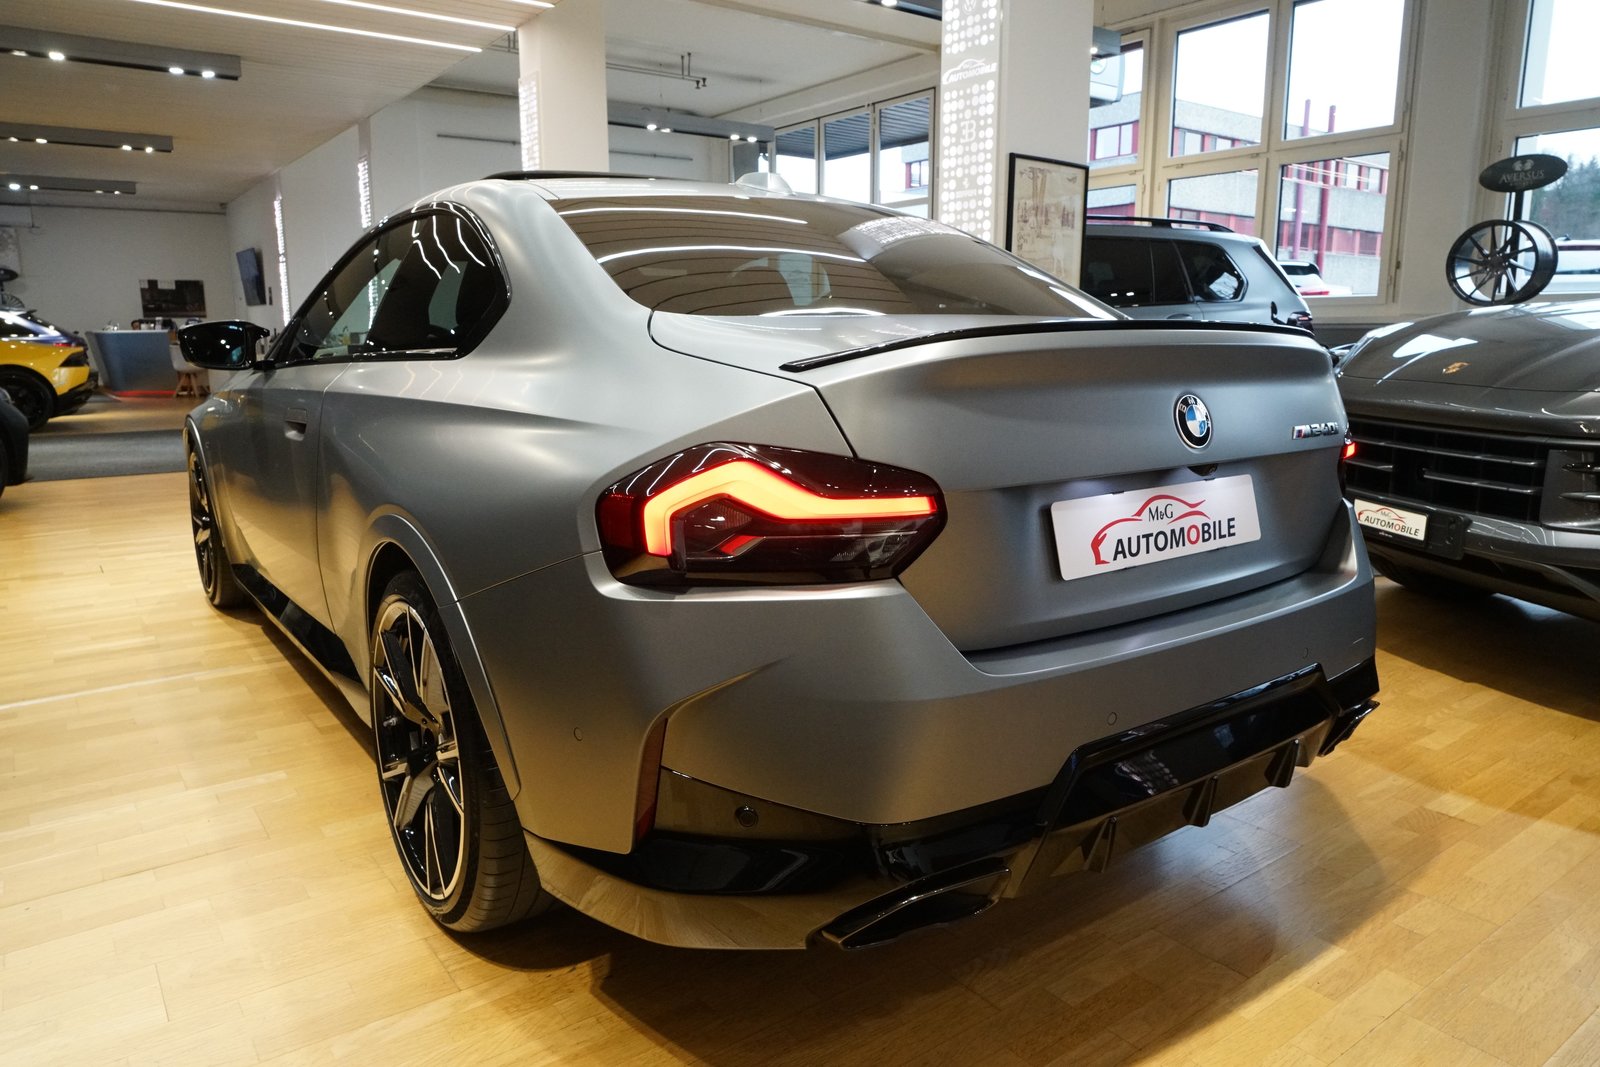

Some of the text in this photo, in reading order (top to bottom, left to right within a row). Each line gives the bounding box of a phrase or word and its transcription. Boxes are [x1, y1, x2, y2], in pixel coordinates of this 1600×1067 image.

[1499, 169, 1545, 184] AVERSUS
[1148, 503, 1174, 522] M&G
[1364, 515, 1420, 537] AUTOMOBILE
[1113, 517, 1236, 561] AUTOMOBILE
